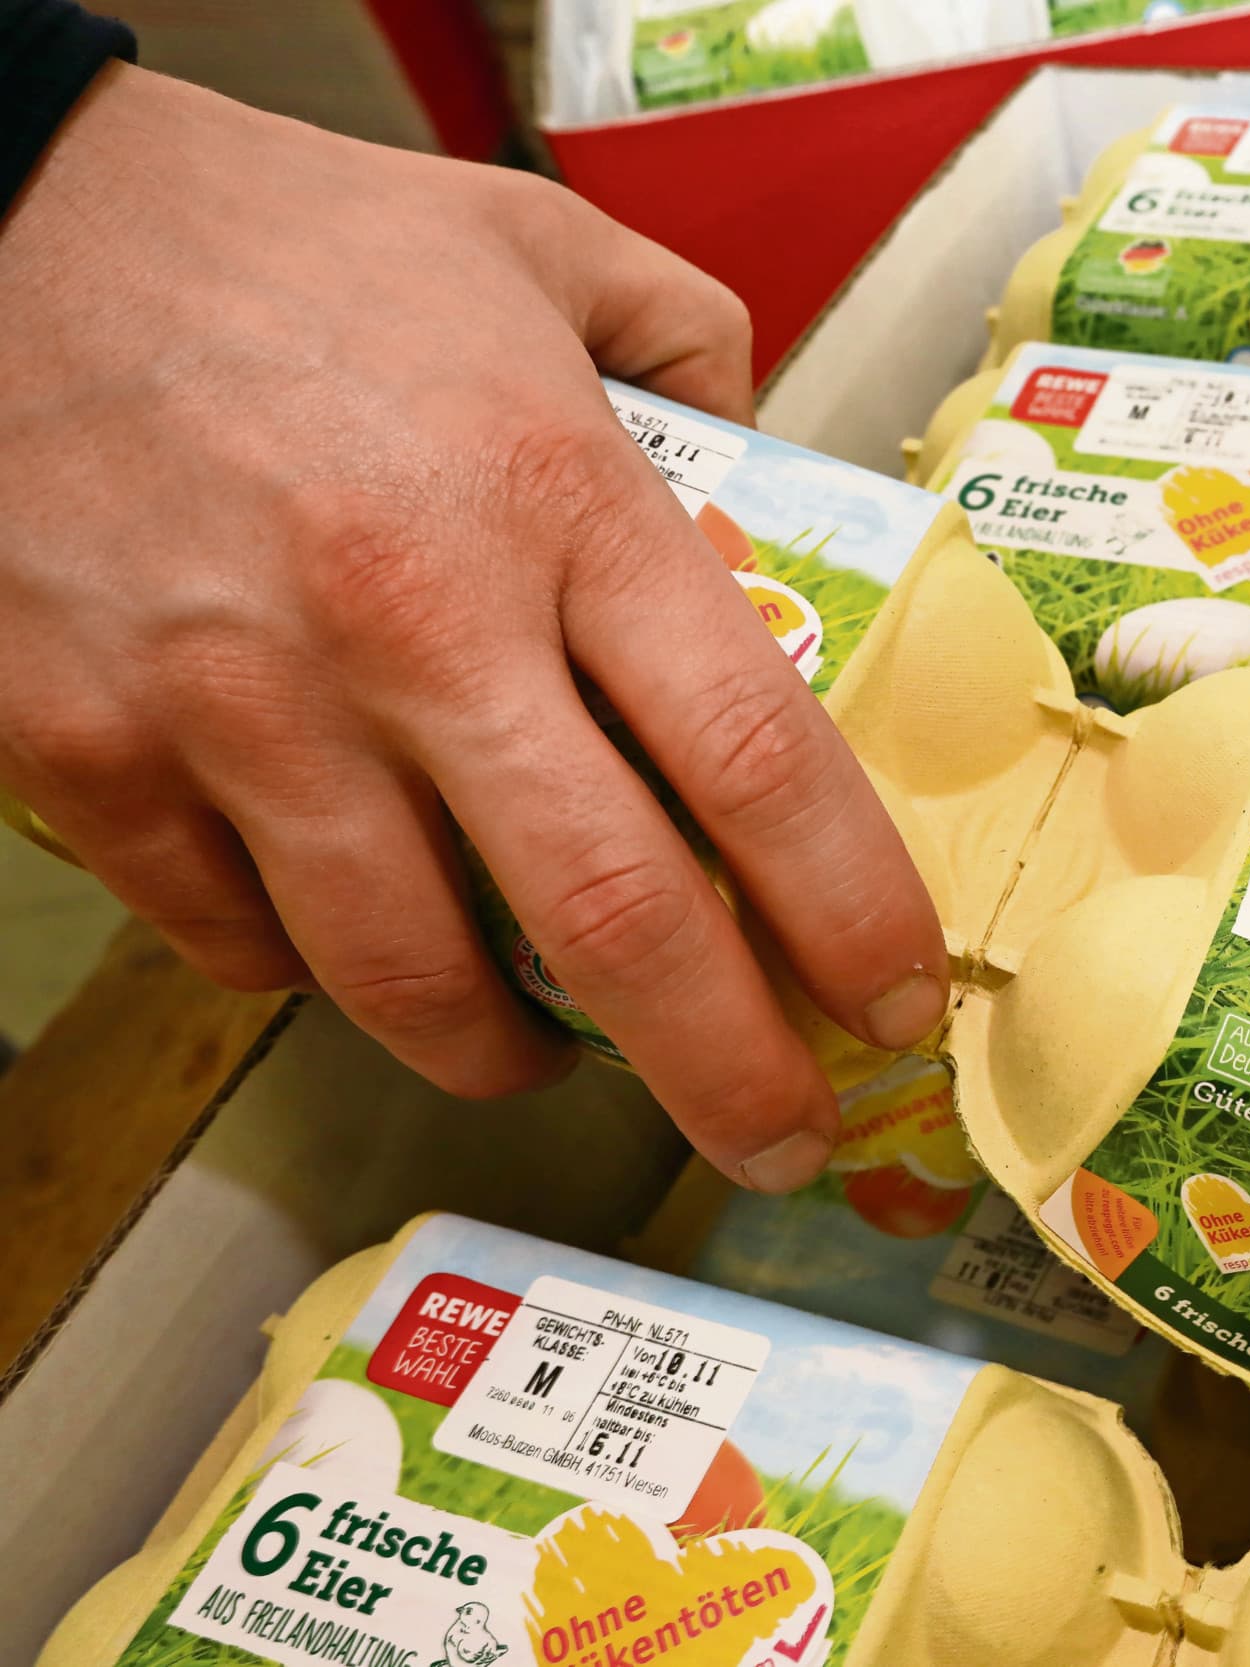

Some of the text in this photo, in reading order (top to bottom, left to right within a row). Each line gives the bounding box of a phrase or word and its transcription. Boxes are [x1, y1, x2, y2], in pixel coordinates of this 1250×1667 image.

[1035, 373, 1102, 395] REWE
[958, 473, 1128, 511] 6 frische
[998, 498, 1067, 523] Eier
[1177, 500, 1244, 536] Ohne
[1199, 1211, 1243, 1230] Ohne
[1154, 1285, 1176, 1301] 6
[419, 1293, 510, 1337] REWE
[536, 1317, 604, 1347] GEWICHTS-
[602, 1311, 690, 1346] PN-Nr NL571
[409, 1327, 482, 1364] BESTE
[533, 1334, 589, 1361] KLASSE:
[392, 1352, 461, 1389] WAHL
[524, 1361, 564, 1398] M
[634, 1346, 721, 1386] Von 10.11
[640, 1391, 654, 1405] zu
[657, 1393, 700, 1417] kühlen
[668, 1380, 687, 1393] bis
[606, 1398, 669, 1428] Mindestens
[467, 1423, 543, 1460] Moos-Butzen
[585, 1462, 623, 1485] 41751
[624, 1472, 669, 1498] Viersen
[576, 1430, 646, 1468] 16.11
[240, 1492, 488, 1586] 6 frische
[287, 1550, 393, 1617] Eier
[197, 1584, 419, 1667] AUS FREILANDHALTUNG
[541, 1594, 647, 1665] Ohne
[568, 1567, 791, 1667] kentöten
